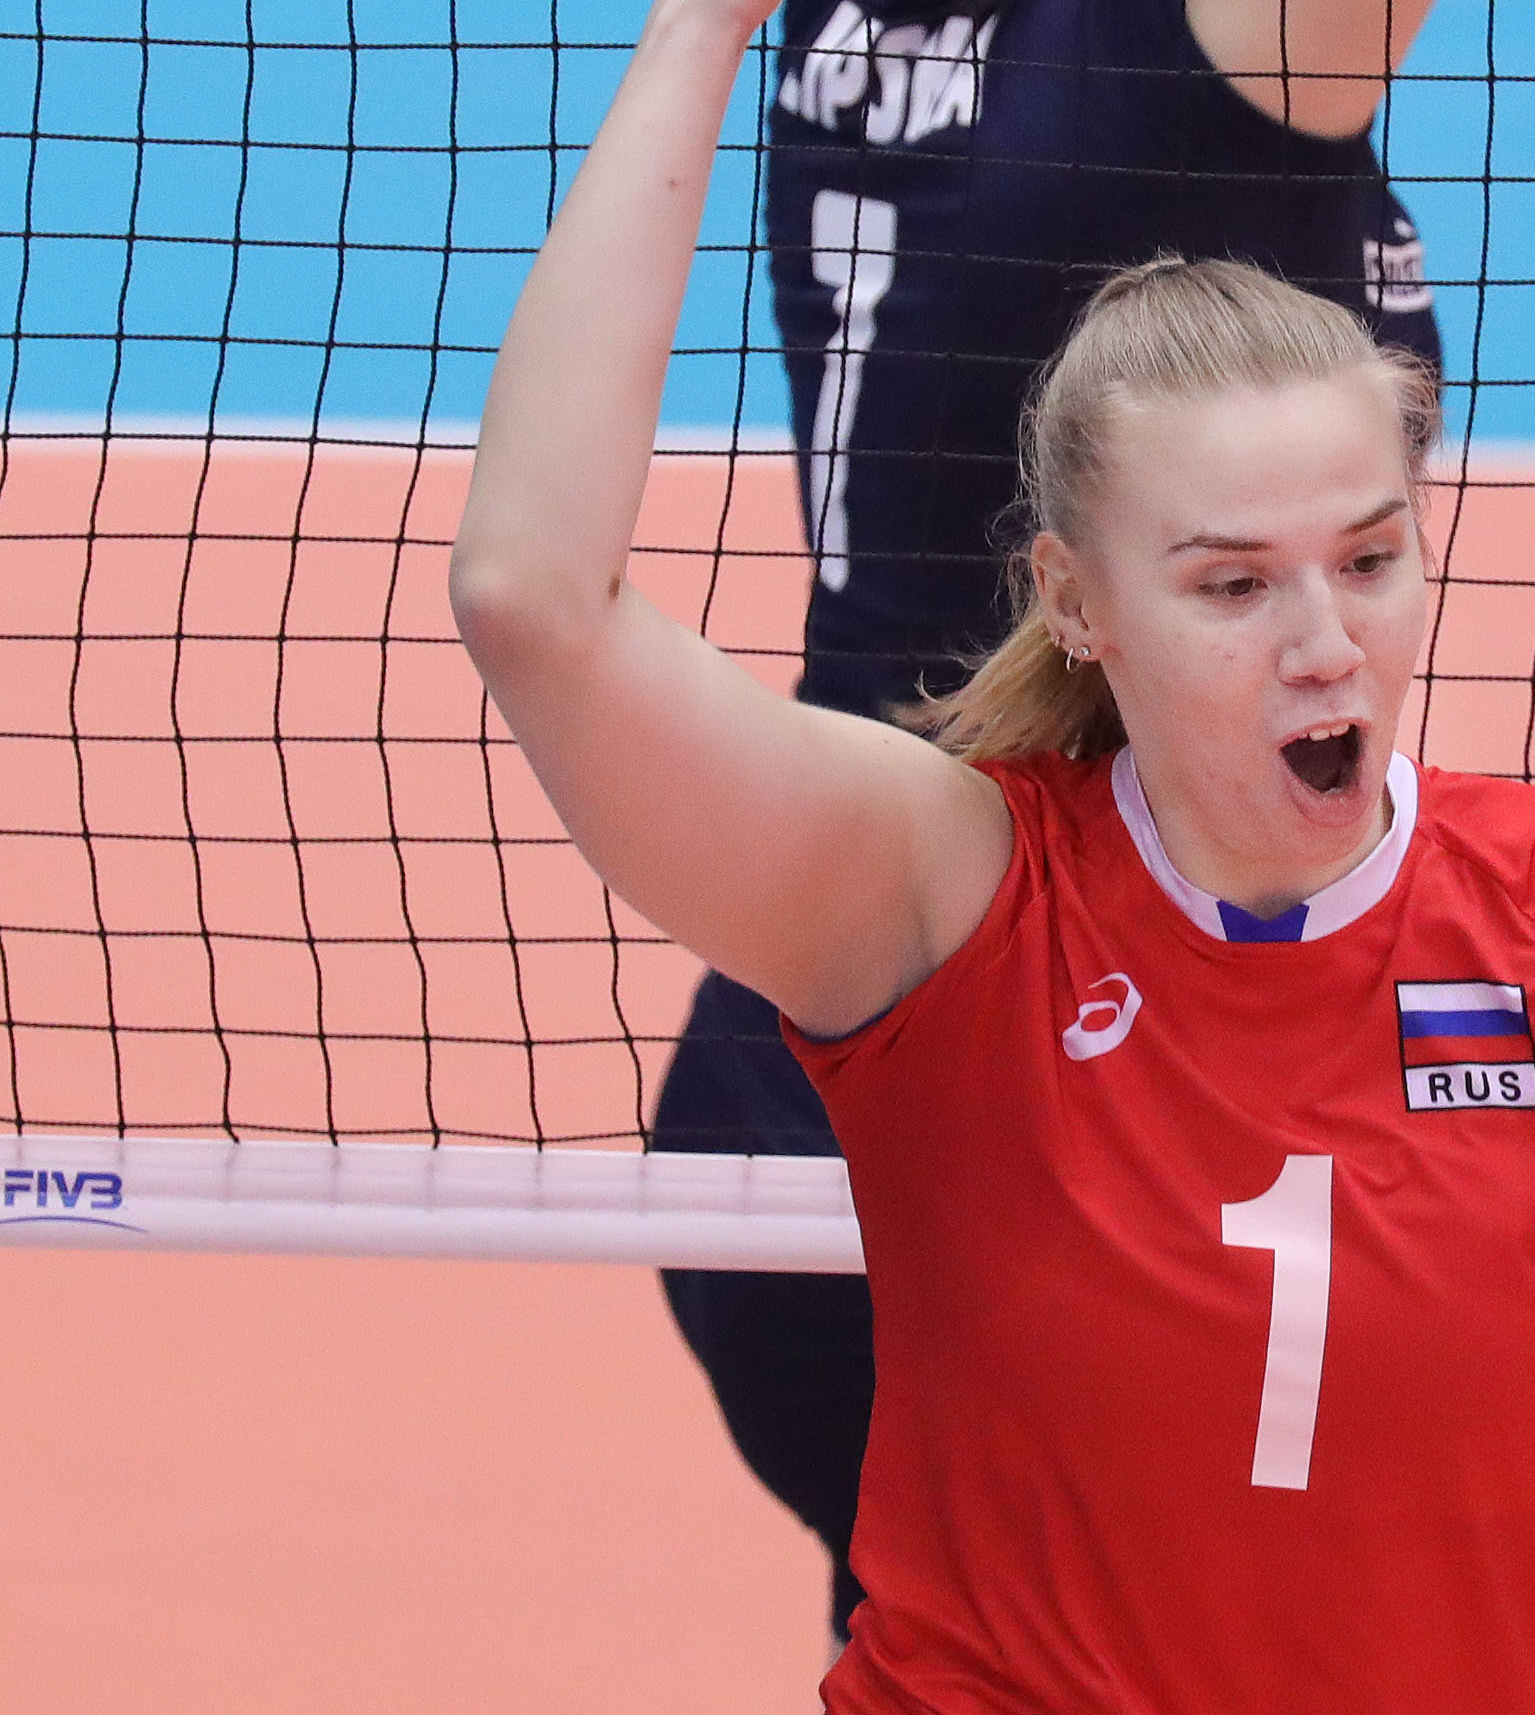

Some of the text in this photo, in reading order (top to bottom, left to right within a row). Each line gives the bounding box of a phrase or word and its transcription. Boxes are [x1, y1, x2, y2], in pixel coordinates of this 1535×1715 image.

[1428, 1070, 1522, 1103] RUS
[4, 1170, 123, 1209] FIVB
[1221, 1154, 1333, 1491] 1
